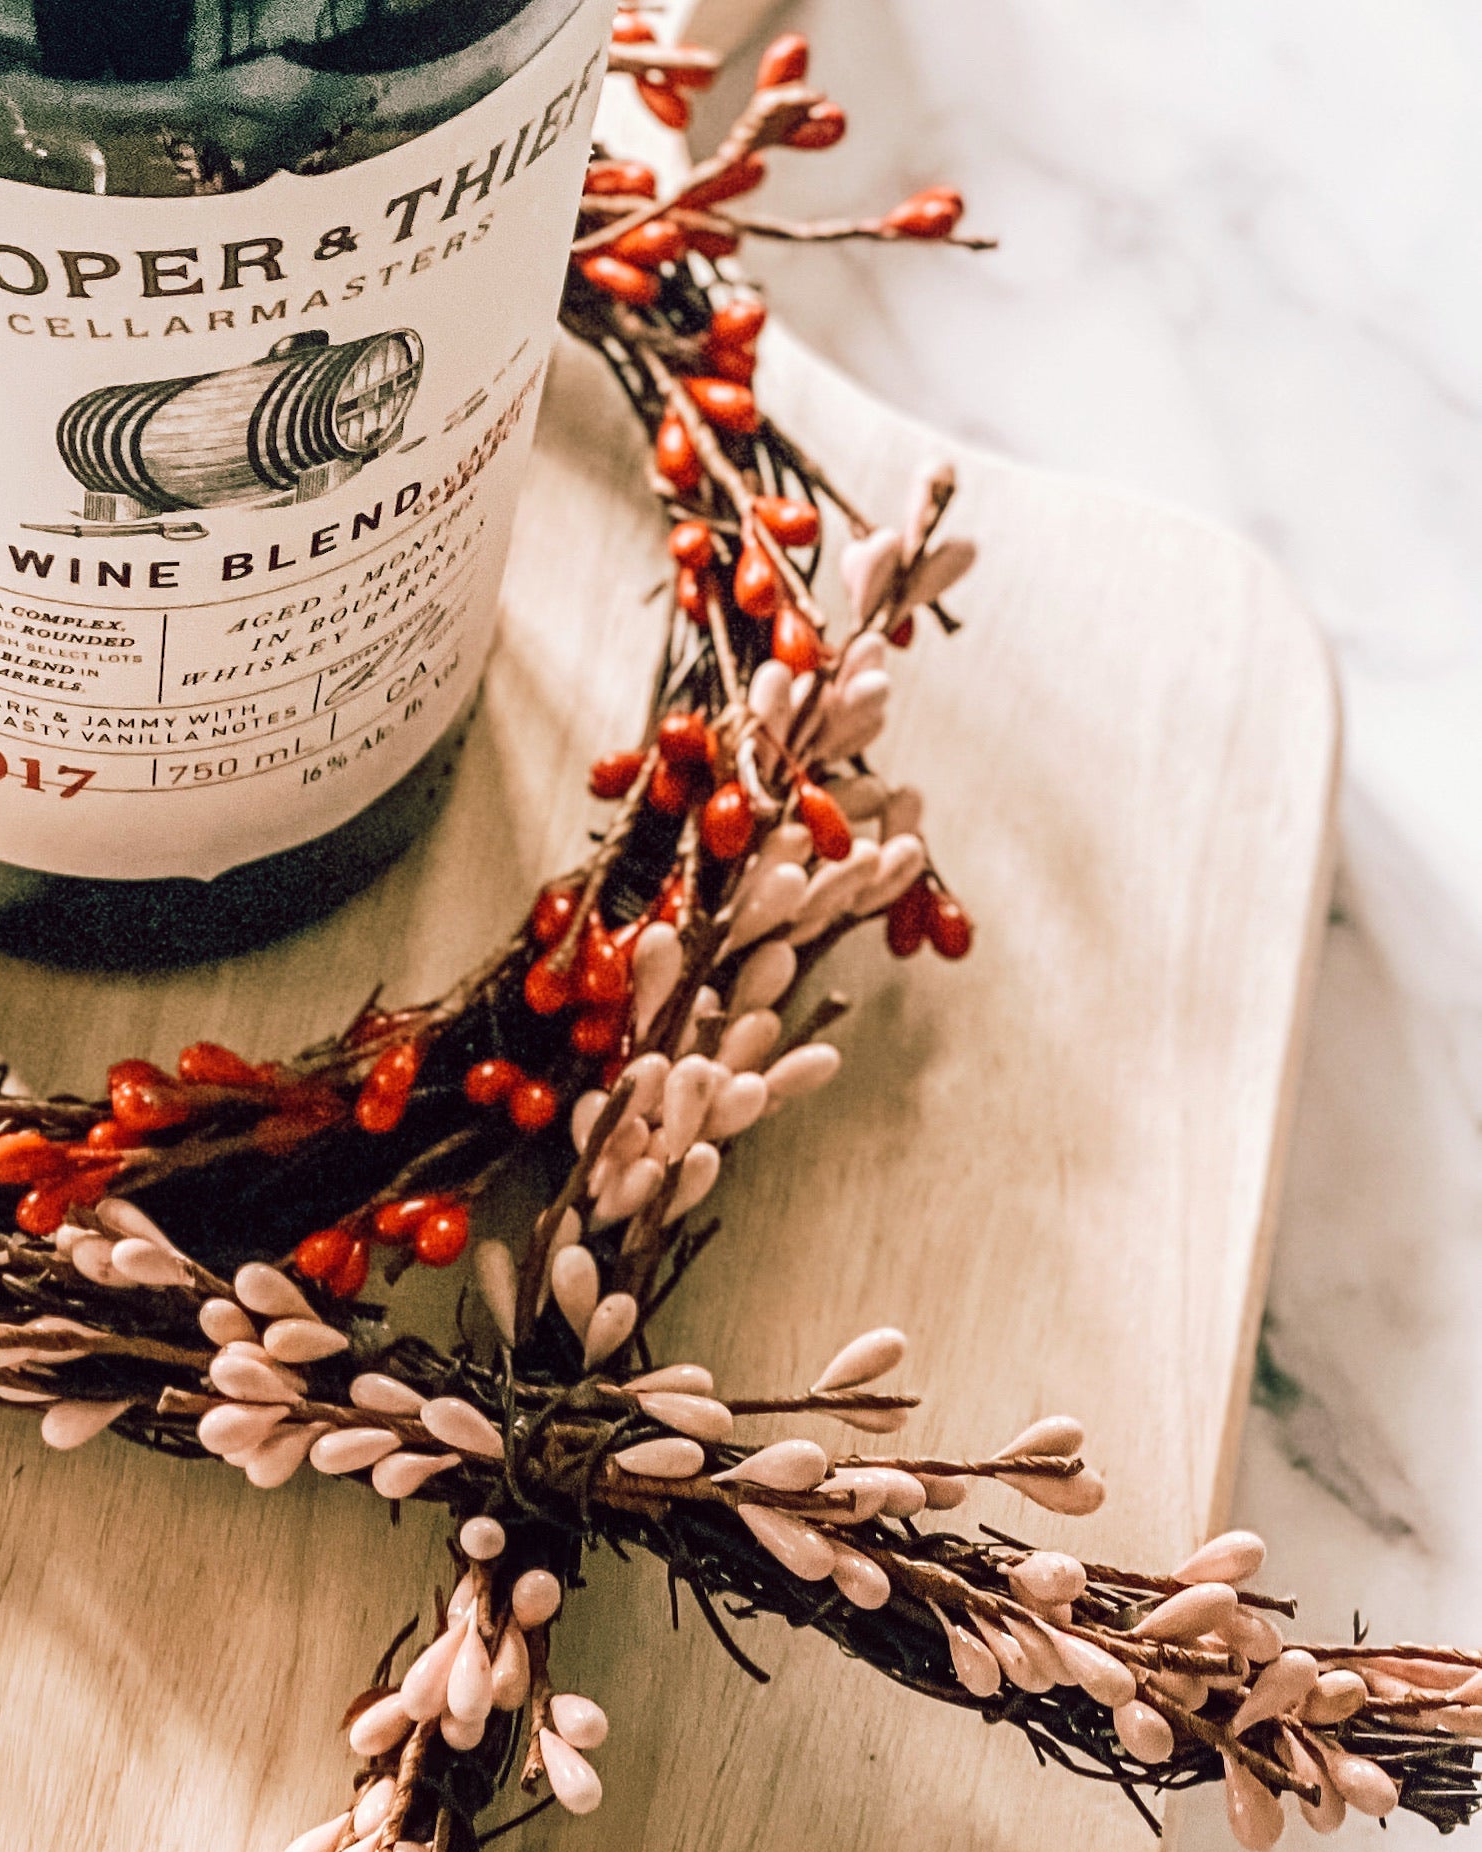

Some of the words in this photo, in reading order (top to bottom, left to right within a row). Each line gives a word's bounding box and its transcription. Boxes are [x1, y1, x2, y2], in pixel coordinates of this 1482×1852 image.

[313, 225, 361, 261] &
[7, 212, 495, 339] CELLARMASTERS
[8, 545, 180, 589] WINE
[222, 482, 422, 582] BLEND
[224, 596, 321, 637] AGED
[332, 583, 348, 601] 3
[251, 628, 292, 652] IN
[308, 535, 450, 634] BOURBON
[11, 605, 127, 632] COMPLEX,
[20, 624, 136, 648] ROUNDED
[0, 651, 76, 676] BLEND
[79, 667, 101, 678] IN
[25, 642, 90, 662] SELECT
[98, 653, 144, 664] LOTS
[181, 626, 350, 687] WHISKEY
[385, 660, 427, 703] CA
[53, 710, 68, 723] &
[85, 714, 176, 729] JAMMY
[188, 702, 257, 726] WITH
[81, 731, 199, 746] VANILLA
[211, 705, 297, 738] NOTES
[168, 757, 239, 786] 750
